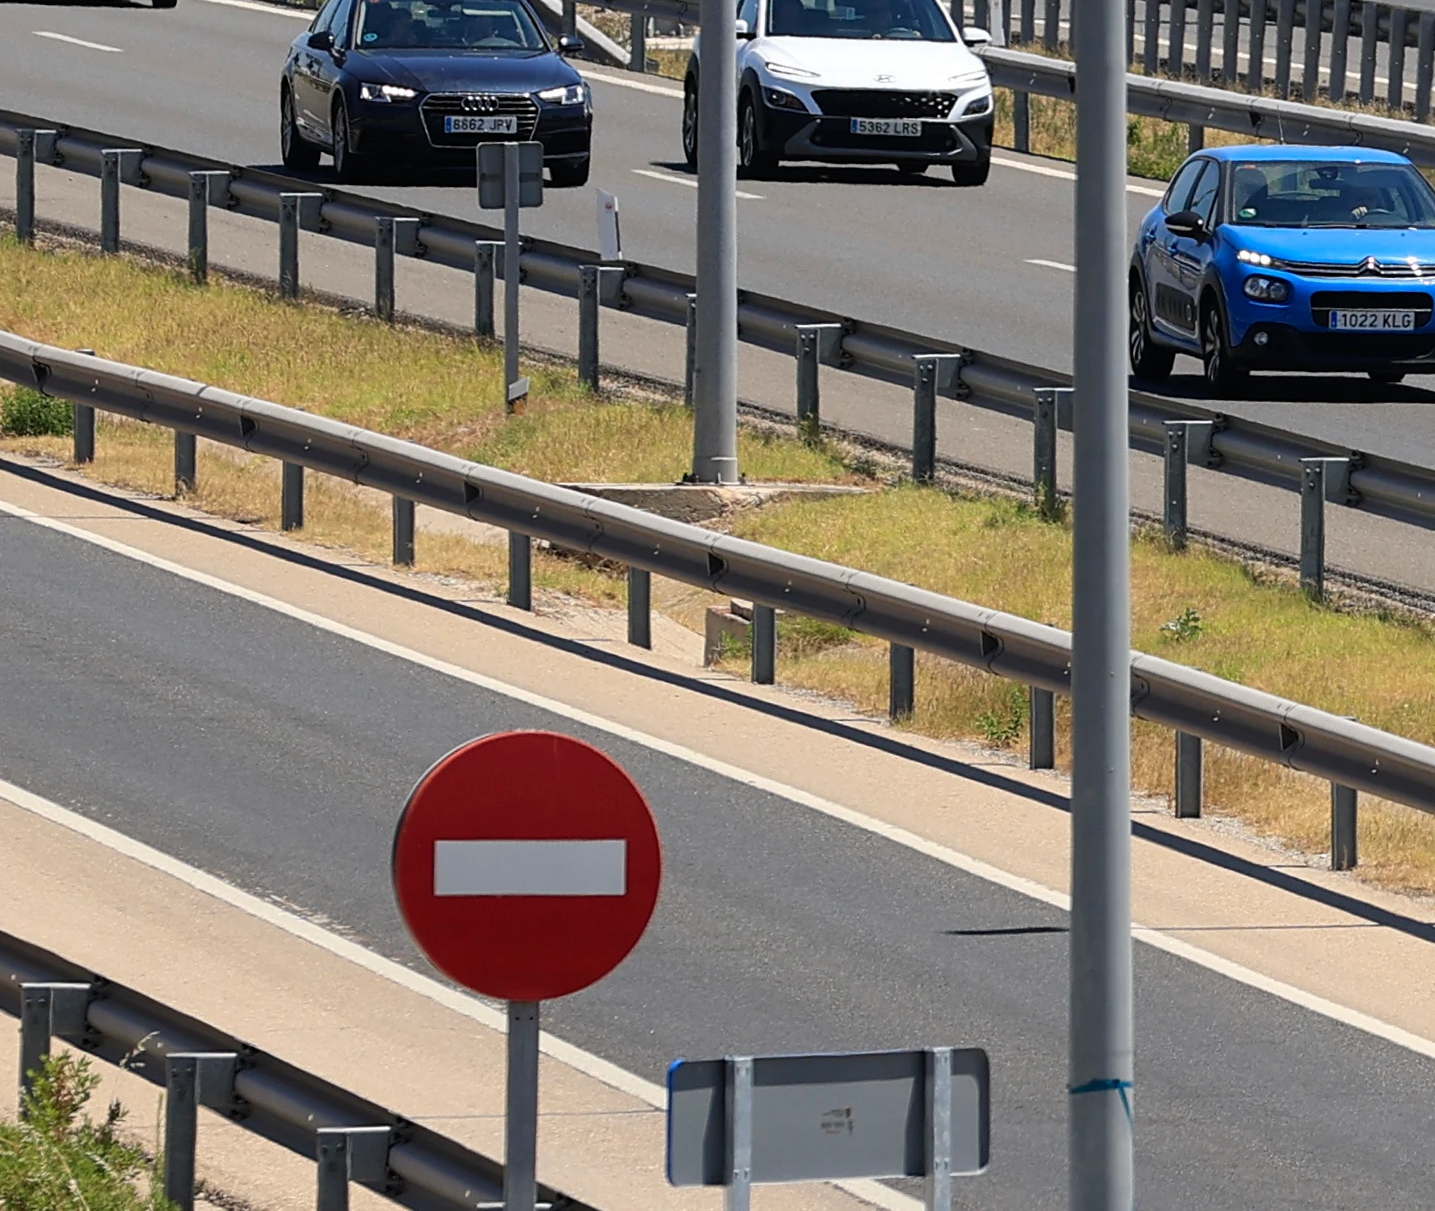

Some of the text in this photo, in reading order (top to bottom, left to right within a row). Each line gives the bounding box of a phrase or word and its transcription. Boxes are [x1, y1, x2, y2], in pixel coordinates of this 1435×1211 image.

[453, 118, 513, 132] 8662 JPV
[859, 120, 919, 135] 5362 LRS
[1341, 313, 1413, 329] 1022 KLG
